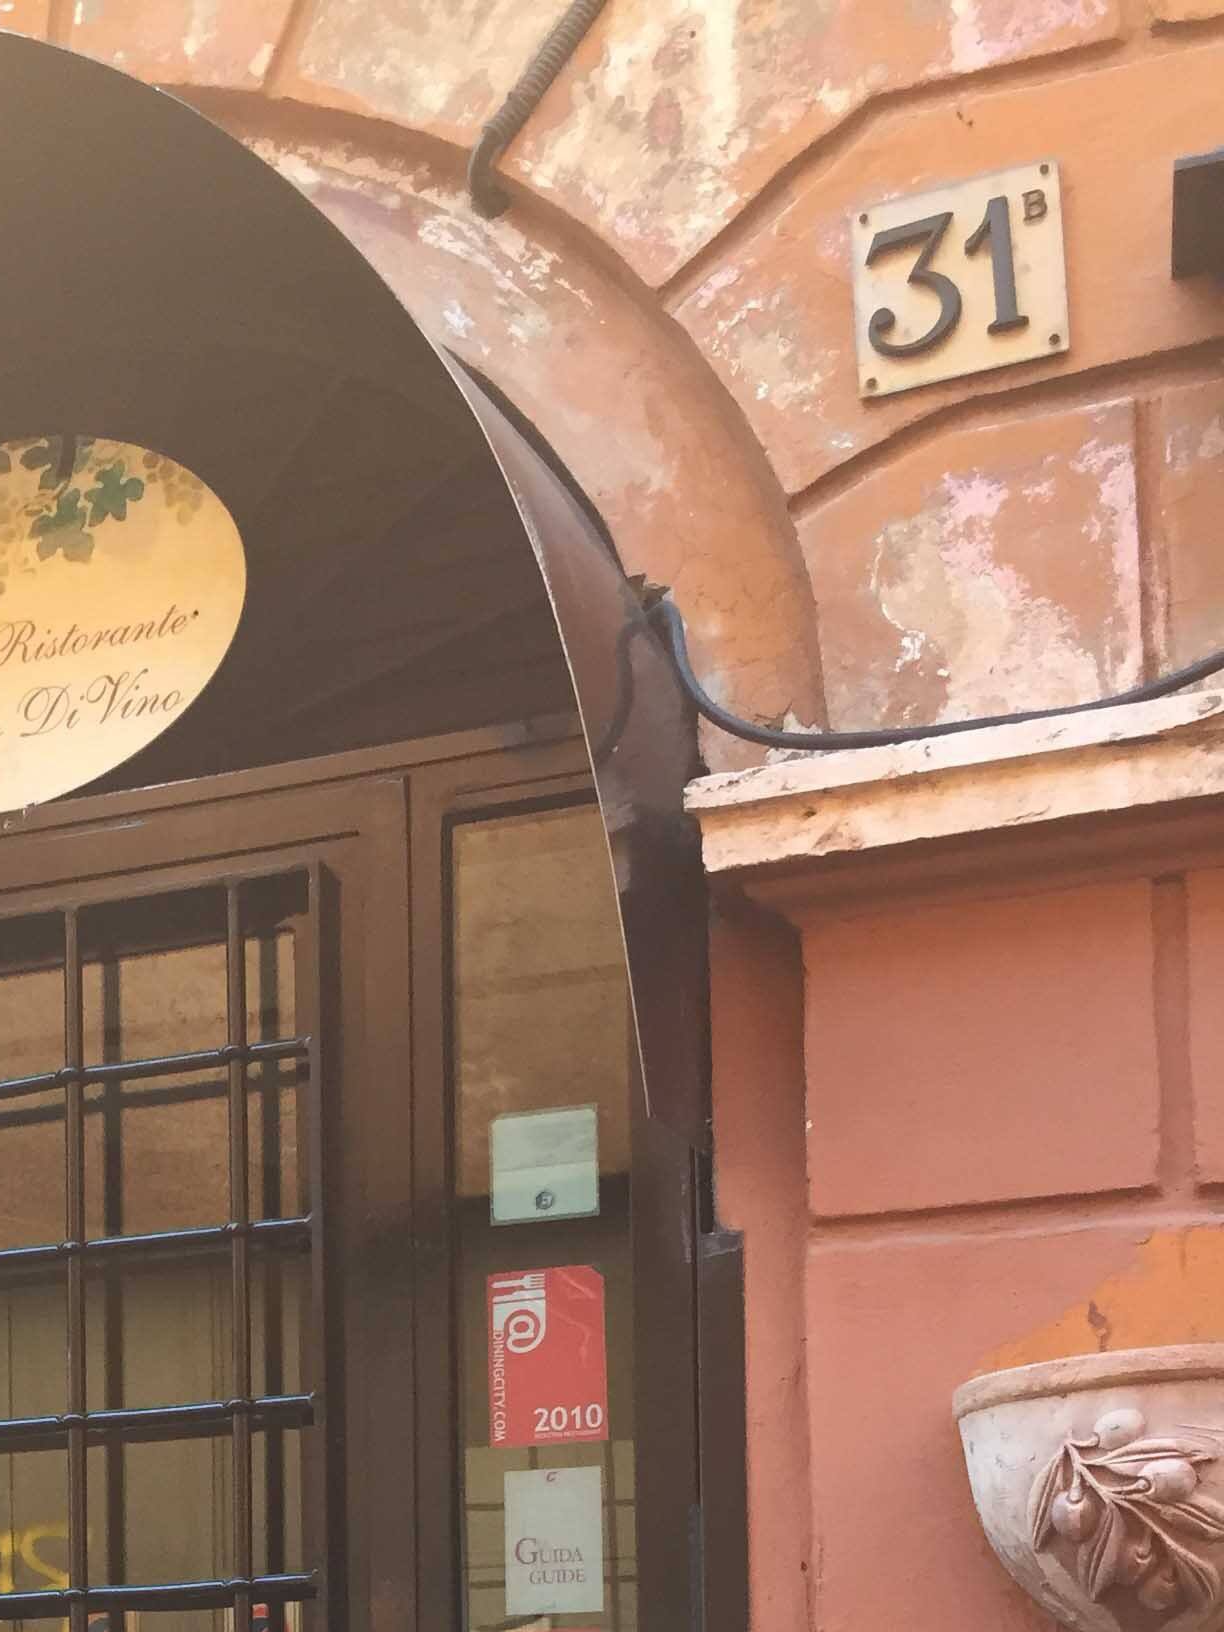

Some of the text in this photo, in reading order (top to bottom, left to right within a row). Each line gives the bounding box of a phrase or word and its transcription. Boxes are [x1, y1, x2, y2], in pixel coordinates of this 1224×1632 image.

[16, 685, 82, 740] Di
[86, 668, 184, 728] Vino
[533, 1403, 604, 1433] 2010
[528, 1567, 587, 1585] GUIDE
